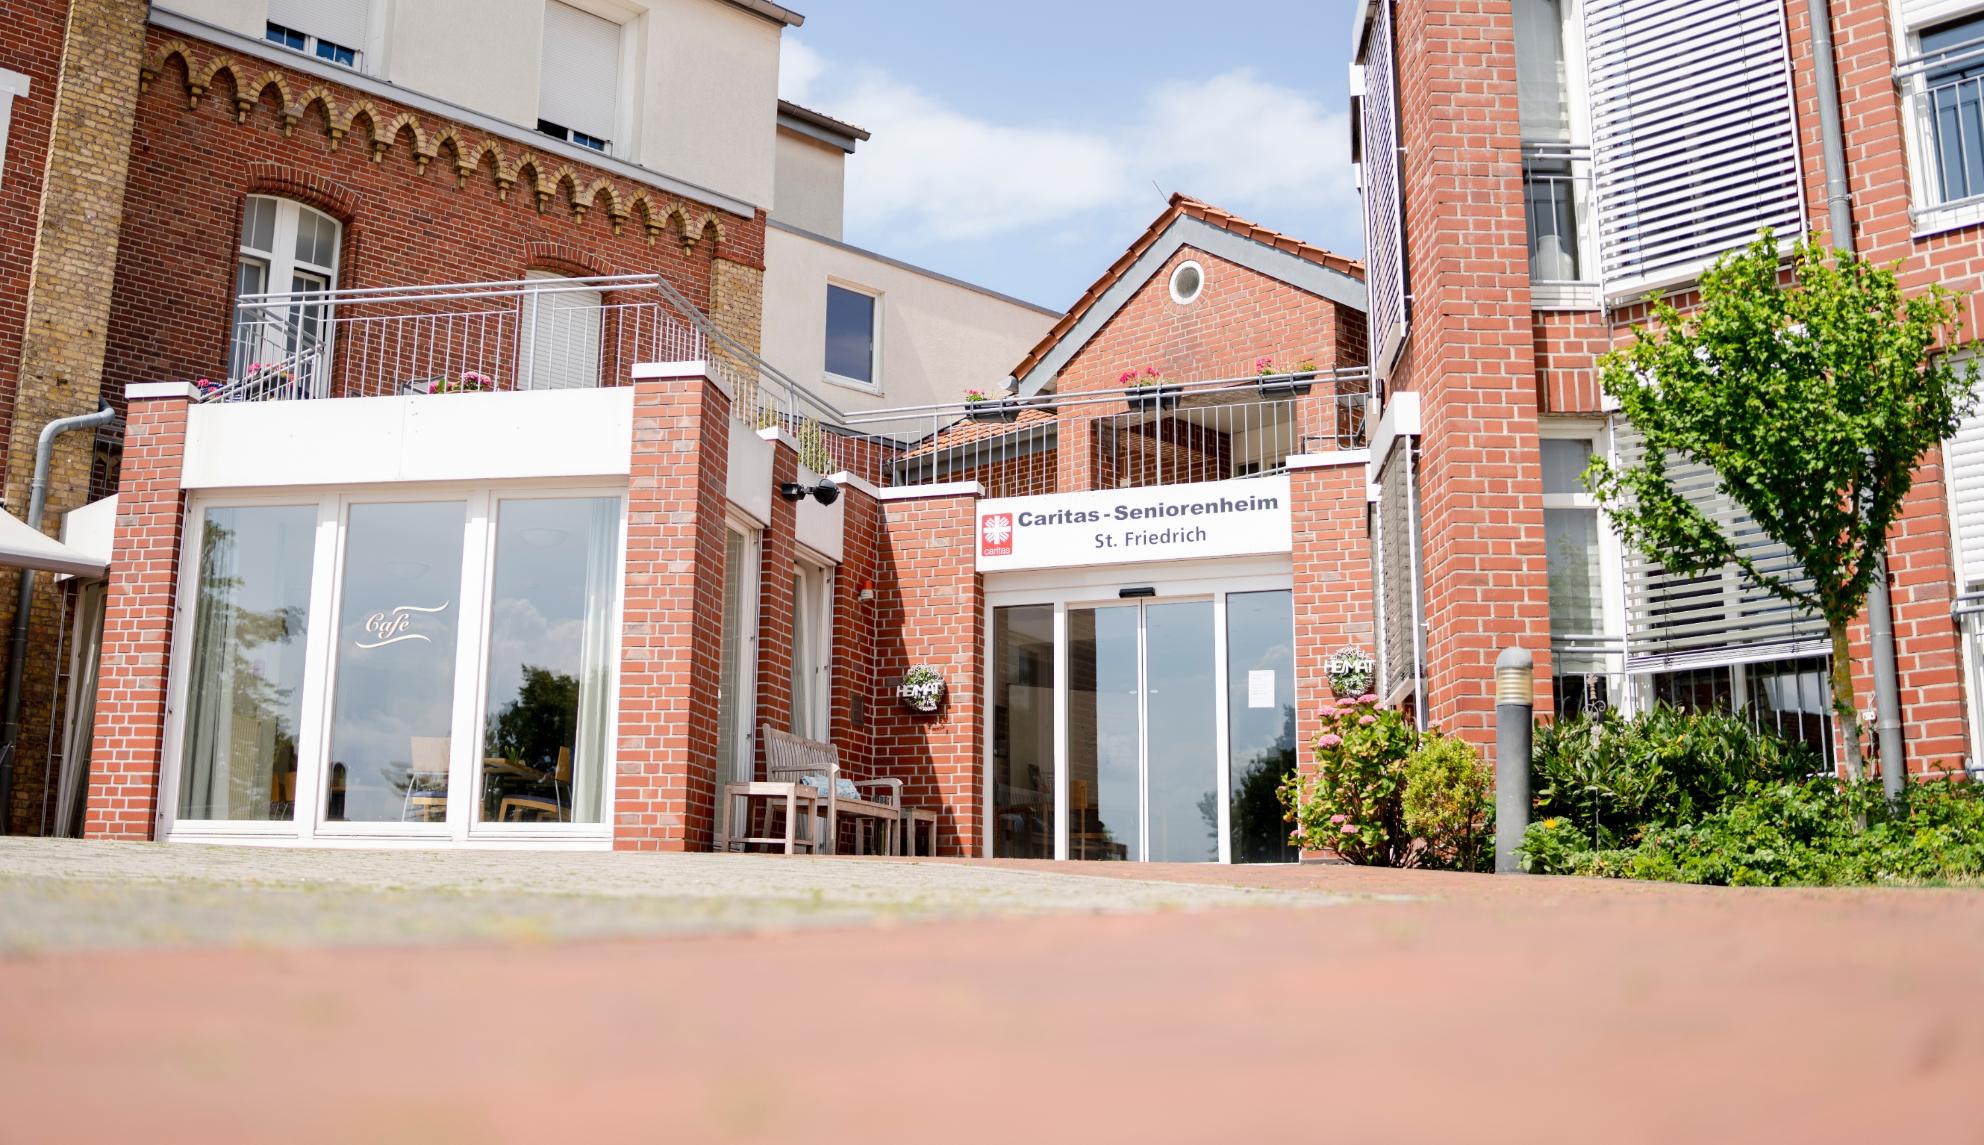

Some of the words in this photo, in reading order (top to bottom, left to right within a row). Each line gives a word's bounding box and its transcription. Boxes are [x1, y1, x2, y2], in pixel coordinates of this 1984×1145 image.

[1095, 533, 1117, 548] St.
[1125, 526, 1206, 547] Friedrich
[983, 547, 1010, 555] caritas
